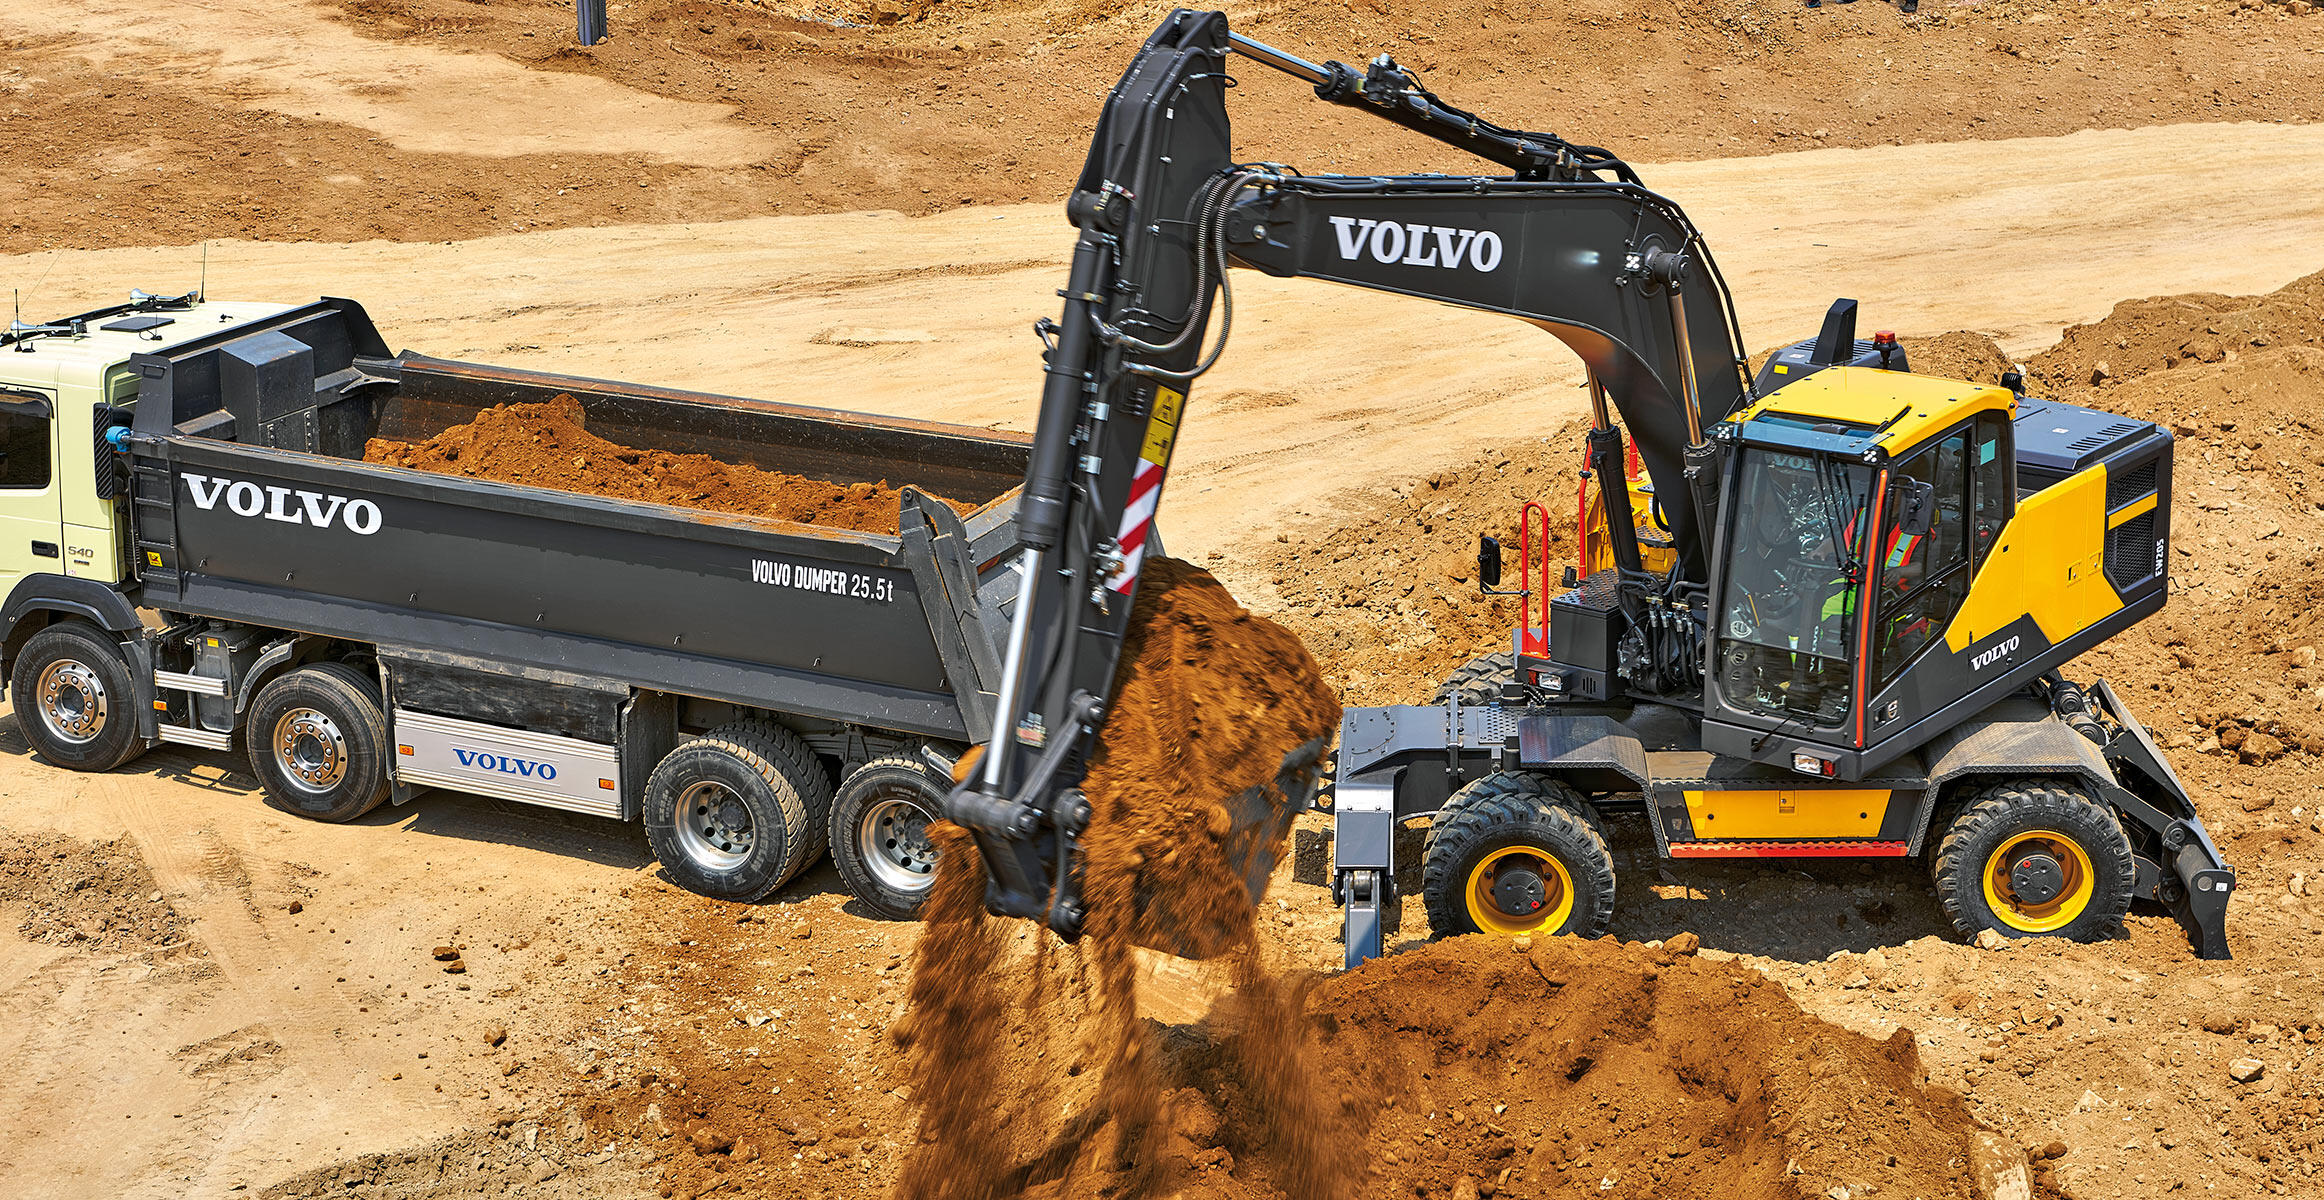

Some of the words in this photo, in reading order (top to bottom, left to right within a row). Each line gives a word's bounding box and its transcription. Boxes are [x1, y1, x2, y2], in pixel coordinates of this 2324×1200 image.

[1329, 215, 1503, 273] VOLVO
[180, 472, 383, 535] VOLVO
[68, 546, 94, 558] 540
[2155, 538, 2165, 577] EW205
[751, 559, 791, 587] VOLVO
[794, 565, 848, 595] DUMPER
[1970, 635, 2020, 672] VOLVO
[452, 748, 557, 780] VOLVO
